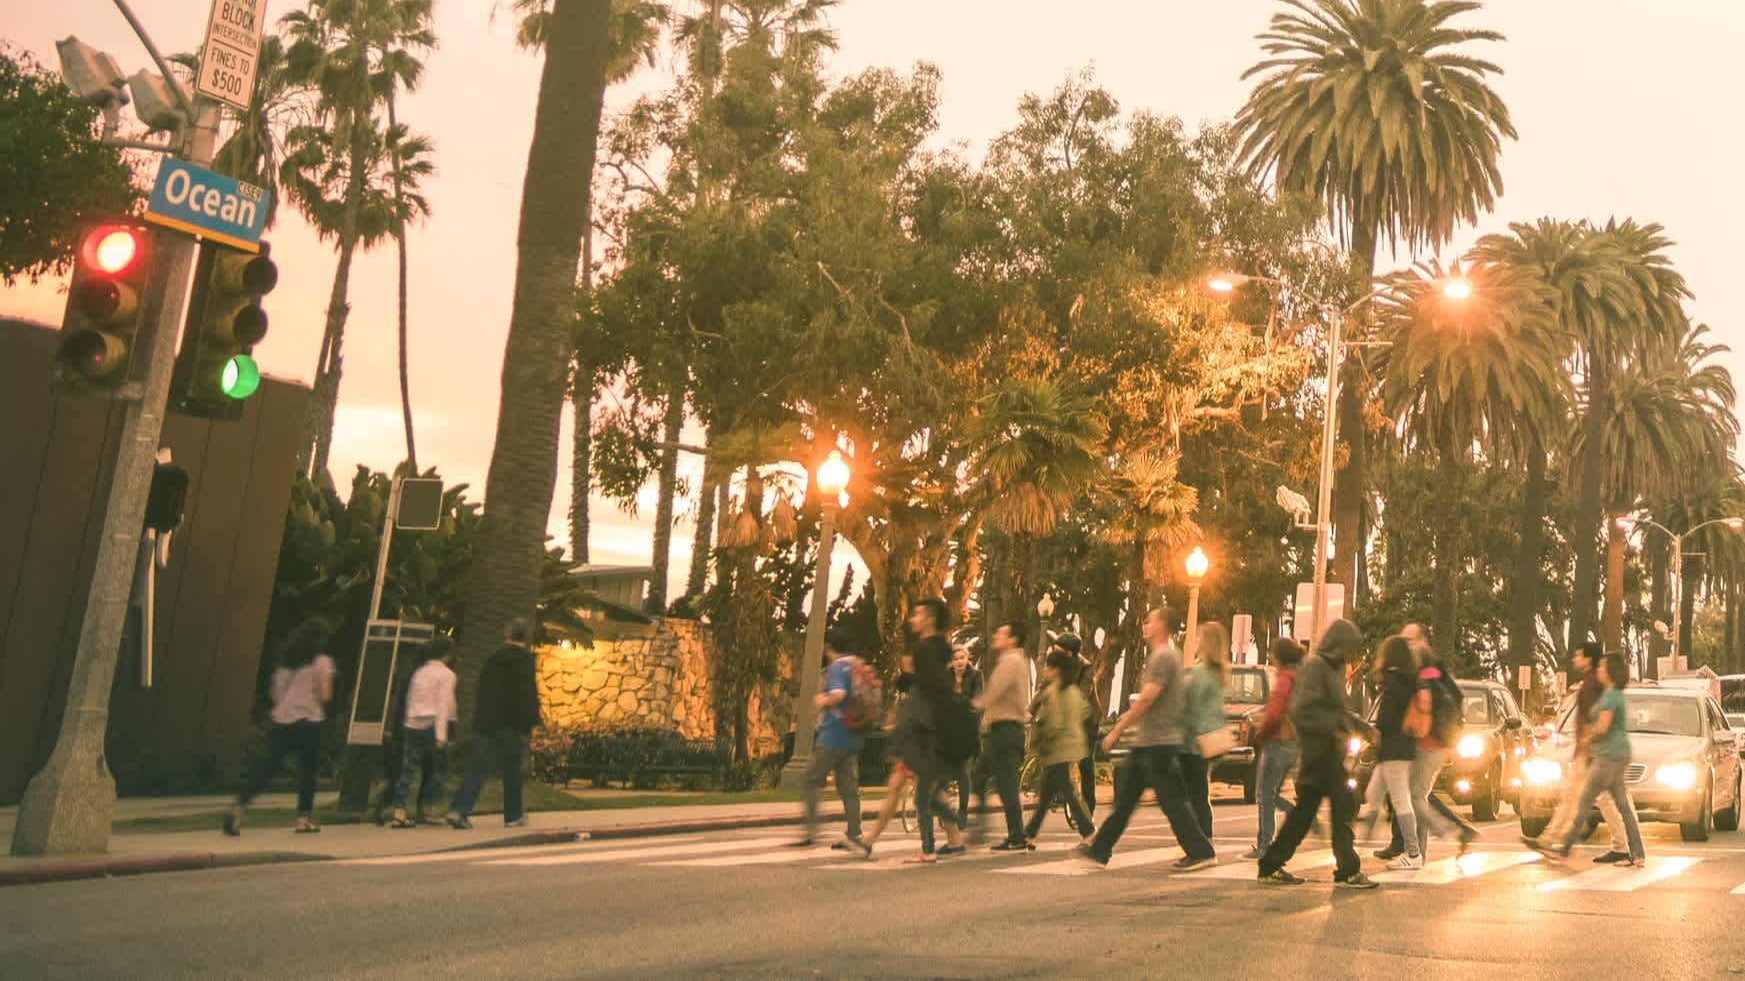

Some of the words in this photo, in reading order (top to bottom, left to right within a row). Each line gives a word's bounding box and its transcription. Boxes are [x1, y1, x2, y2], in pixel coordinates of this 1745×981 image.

[222, 2, 256, 33] BLOCK
[210, 48, 238, 71] FINES
[240, 58, 250, 75] TO
[212, 68, 242, 96] $500
[165, 168, 257, 229] Ocean
